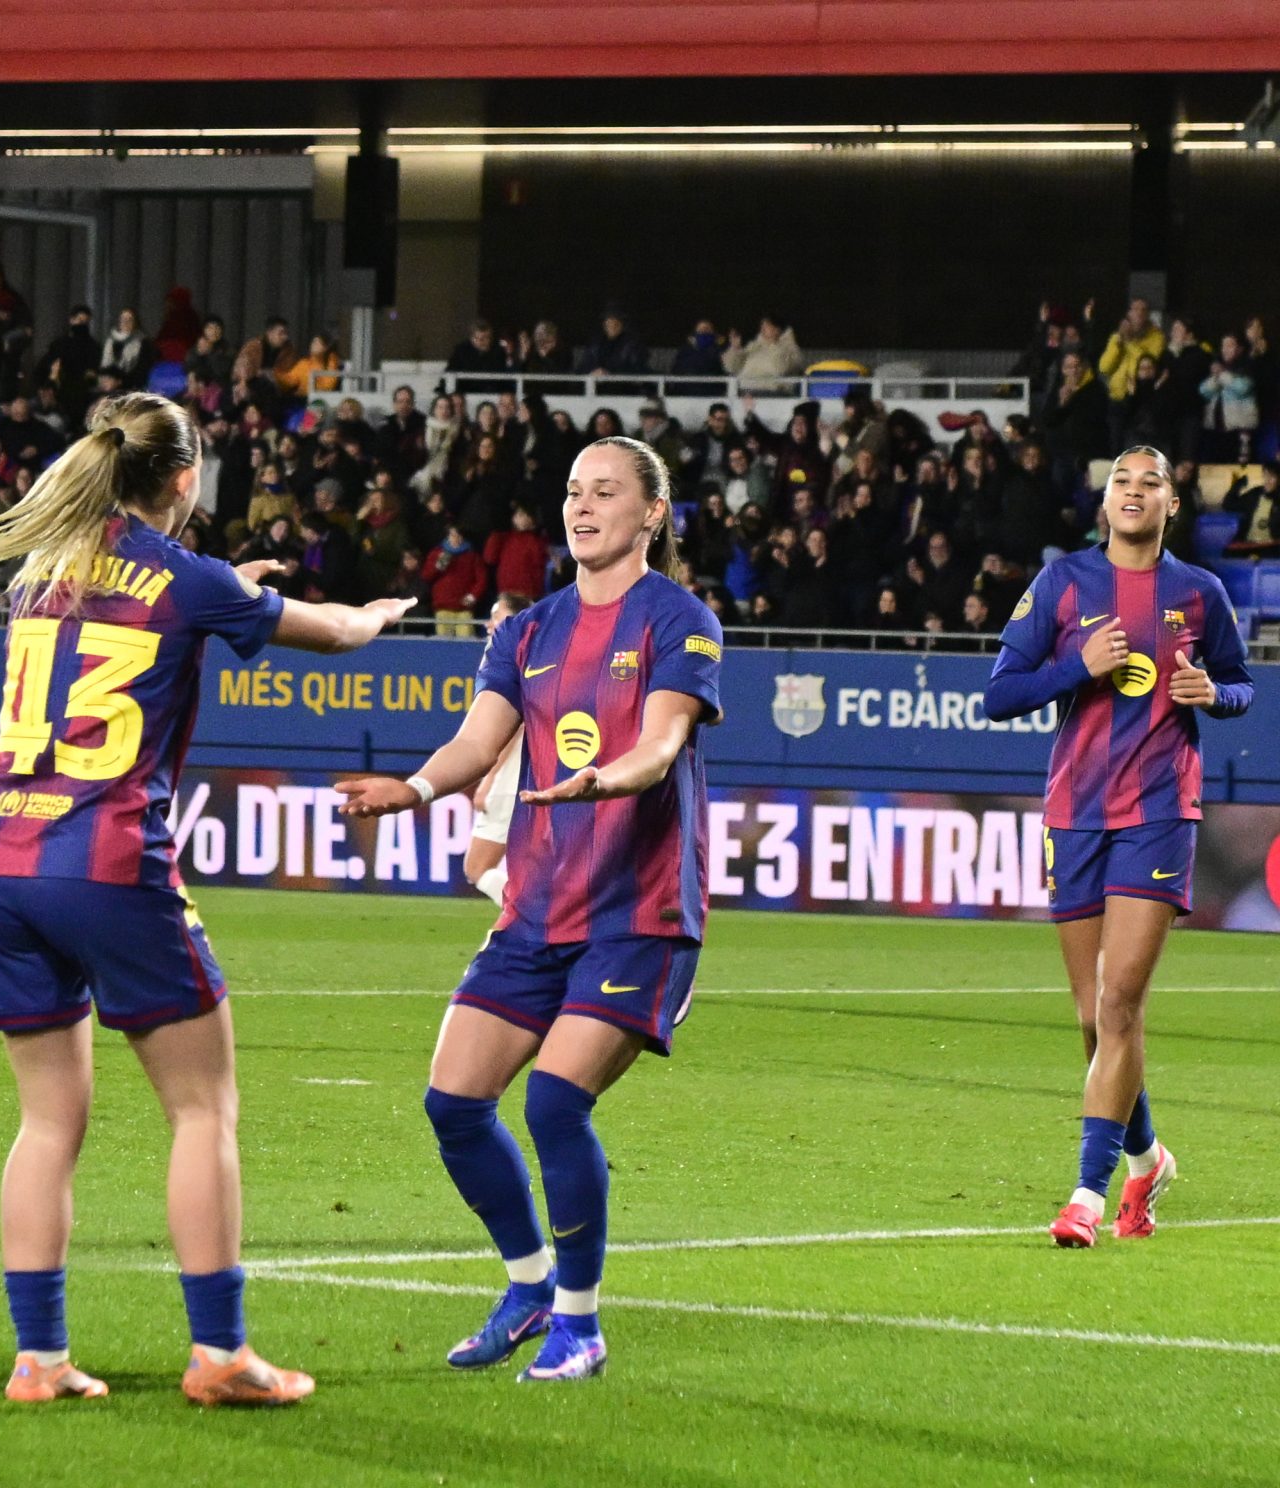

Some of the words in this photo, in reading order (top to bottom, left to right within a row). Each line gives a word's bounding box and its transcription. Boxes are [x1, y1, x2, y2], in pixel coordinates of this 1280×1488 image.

[219, 660, 294, 707] MÉS
[301, 672, 374, 716] QUE
[382, 674, 433, 711] UN
[442, 676, 474, 712] CL
[836, 687, 882, 727] FC
[236, 783, 366, 881] DTE.
[374, 806, 419, 881] A
[429, 792, 472, 883] P
[707, 801, 746, 896] E
[754, 803, 800, 899] 3
